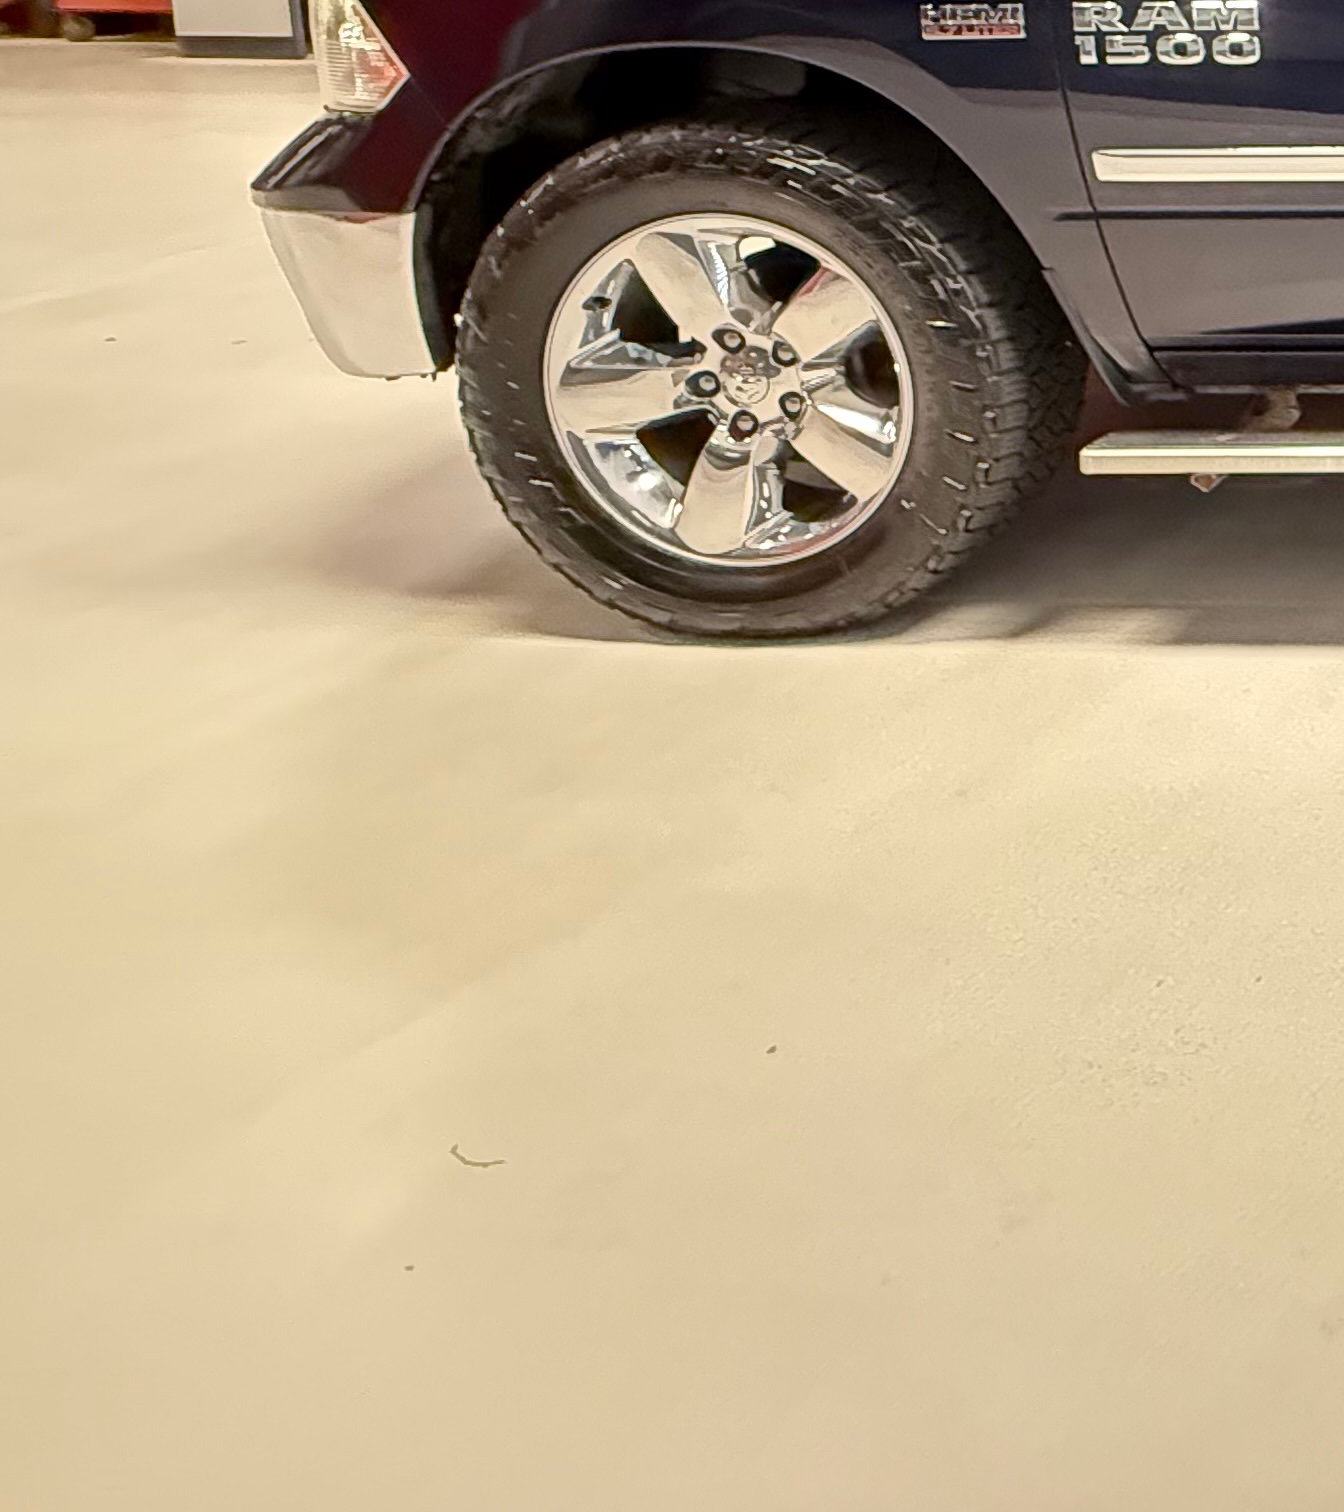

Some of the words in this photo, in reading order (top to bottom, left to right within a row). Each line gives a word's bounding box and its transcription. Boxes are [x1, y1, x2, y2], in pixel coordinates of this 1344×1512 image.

[920, 4, 1025, 25] HEMI
[1072, 0, 1260, 32] RAM
[1074, 34, 1261, 65] 1500
